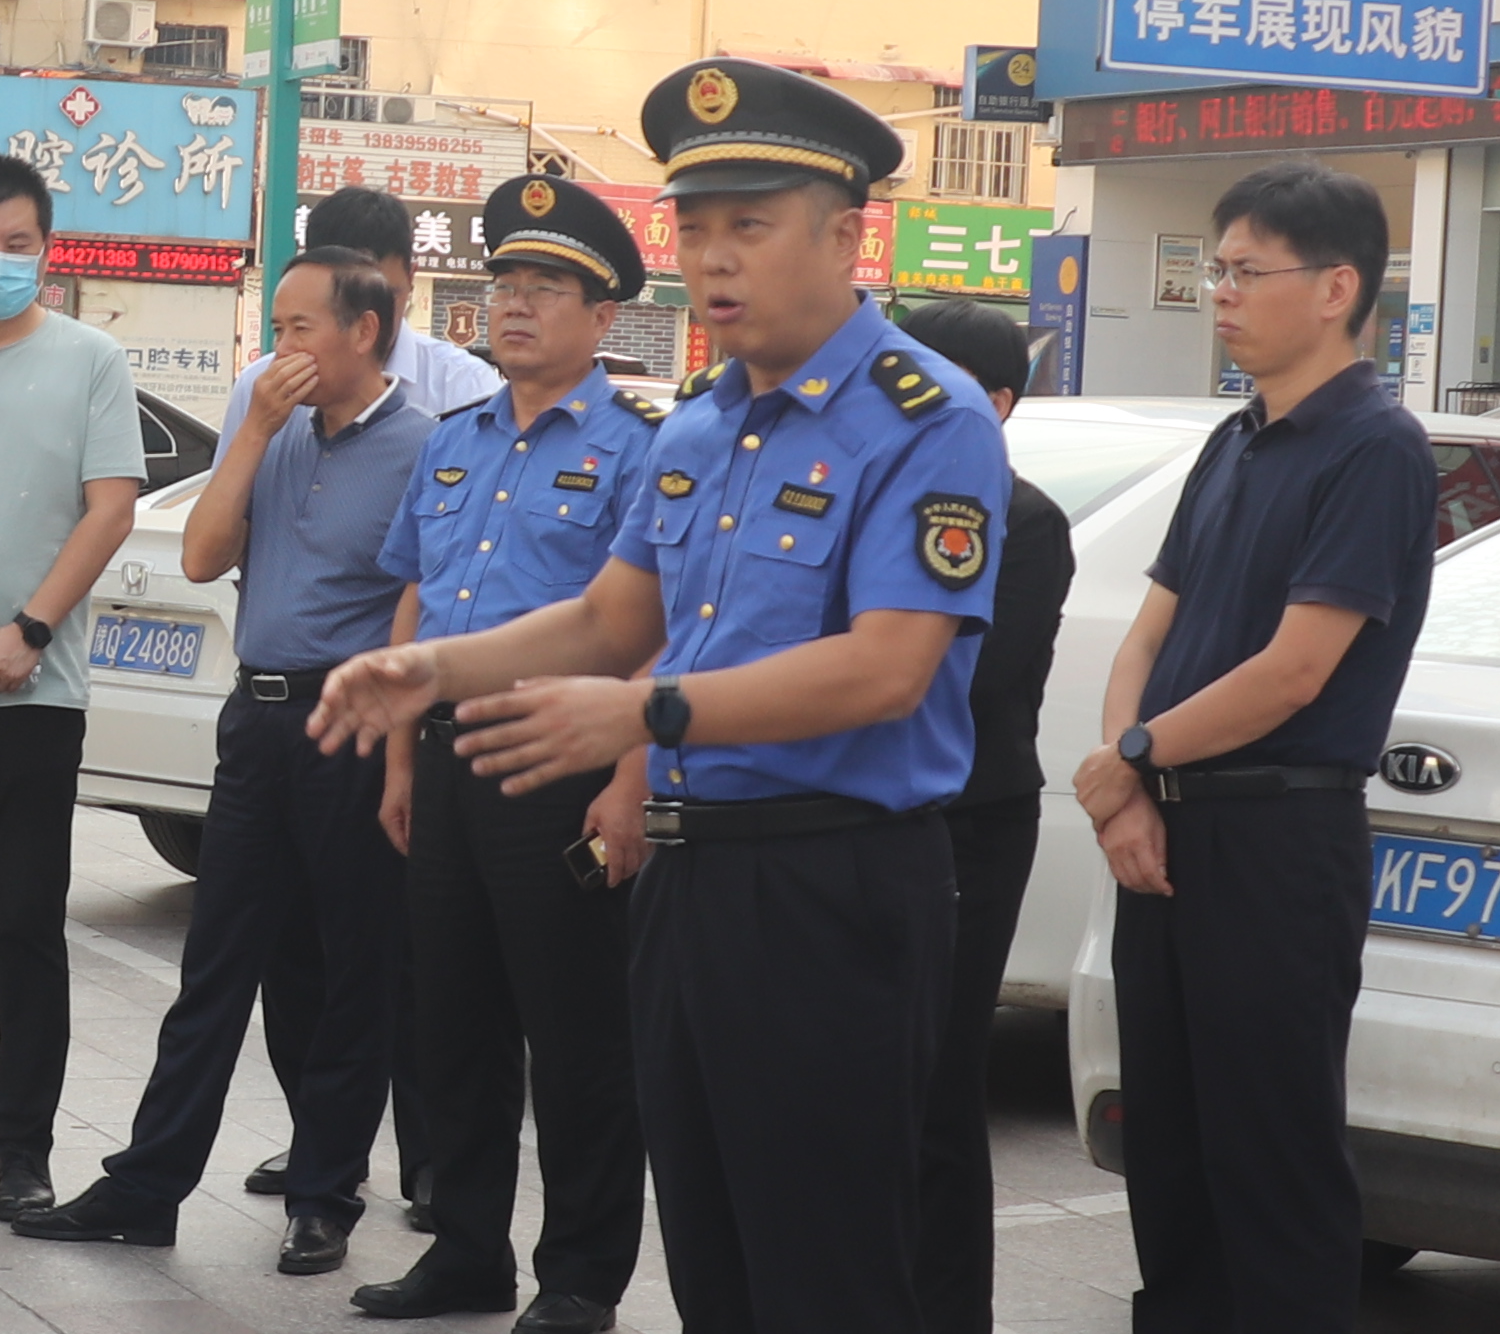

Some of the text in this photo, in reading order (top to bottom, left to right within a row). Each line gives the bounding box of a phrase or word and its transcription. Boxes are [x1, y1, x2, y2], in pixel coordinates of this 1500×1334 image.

[1011, 60, 1030, 74] 24
[363, 132, 484, 154] 13839596255
[385, 159, 484, 201] 古琴教室
[412, 210, 451, 254] 美
[922, 225, 1053, 274] 三七
[126, 347, 220, 373] 口腔专科
[1386, 752, 1444, 785] KIA
